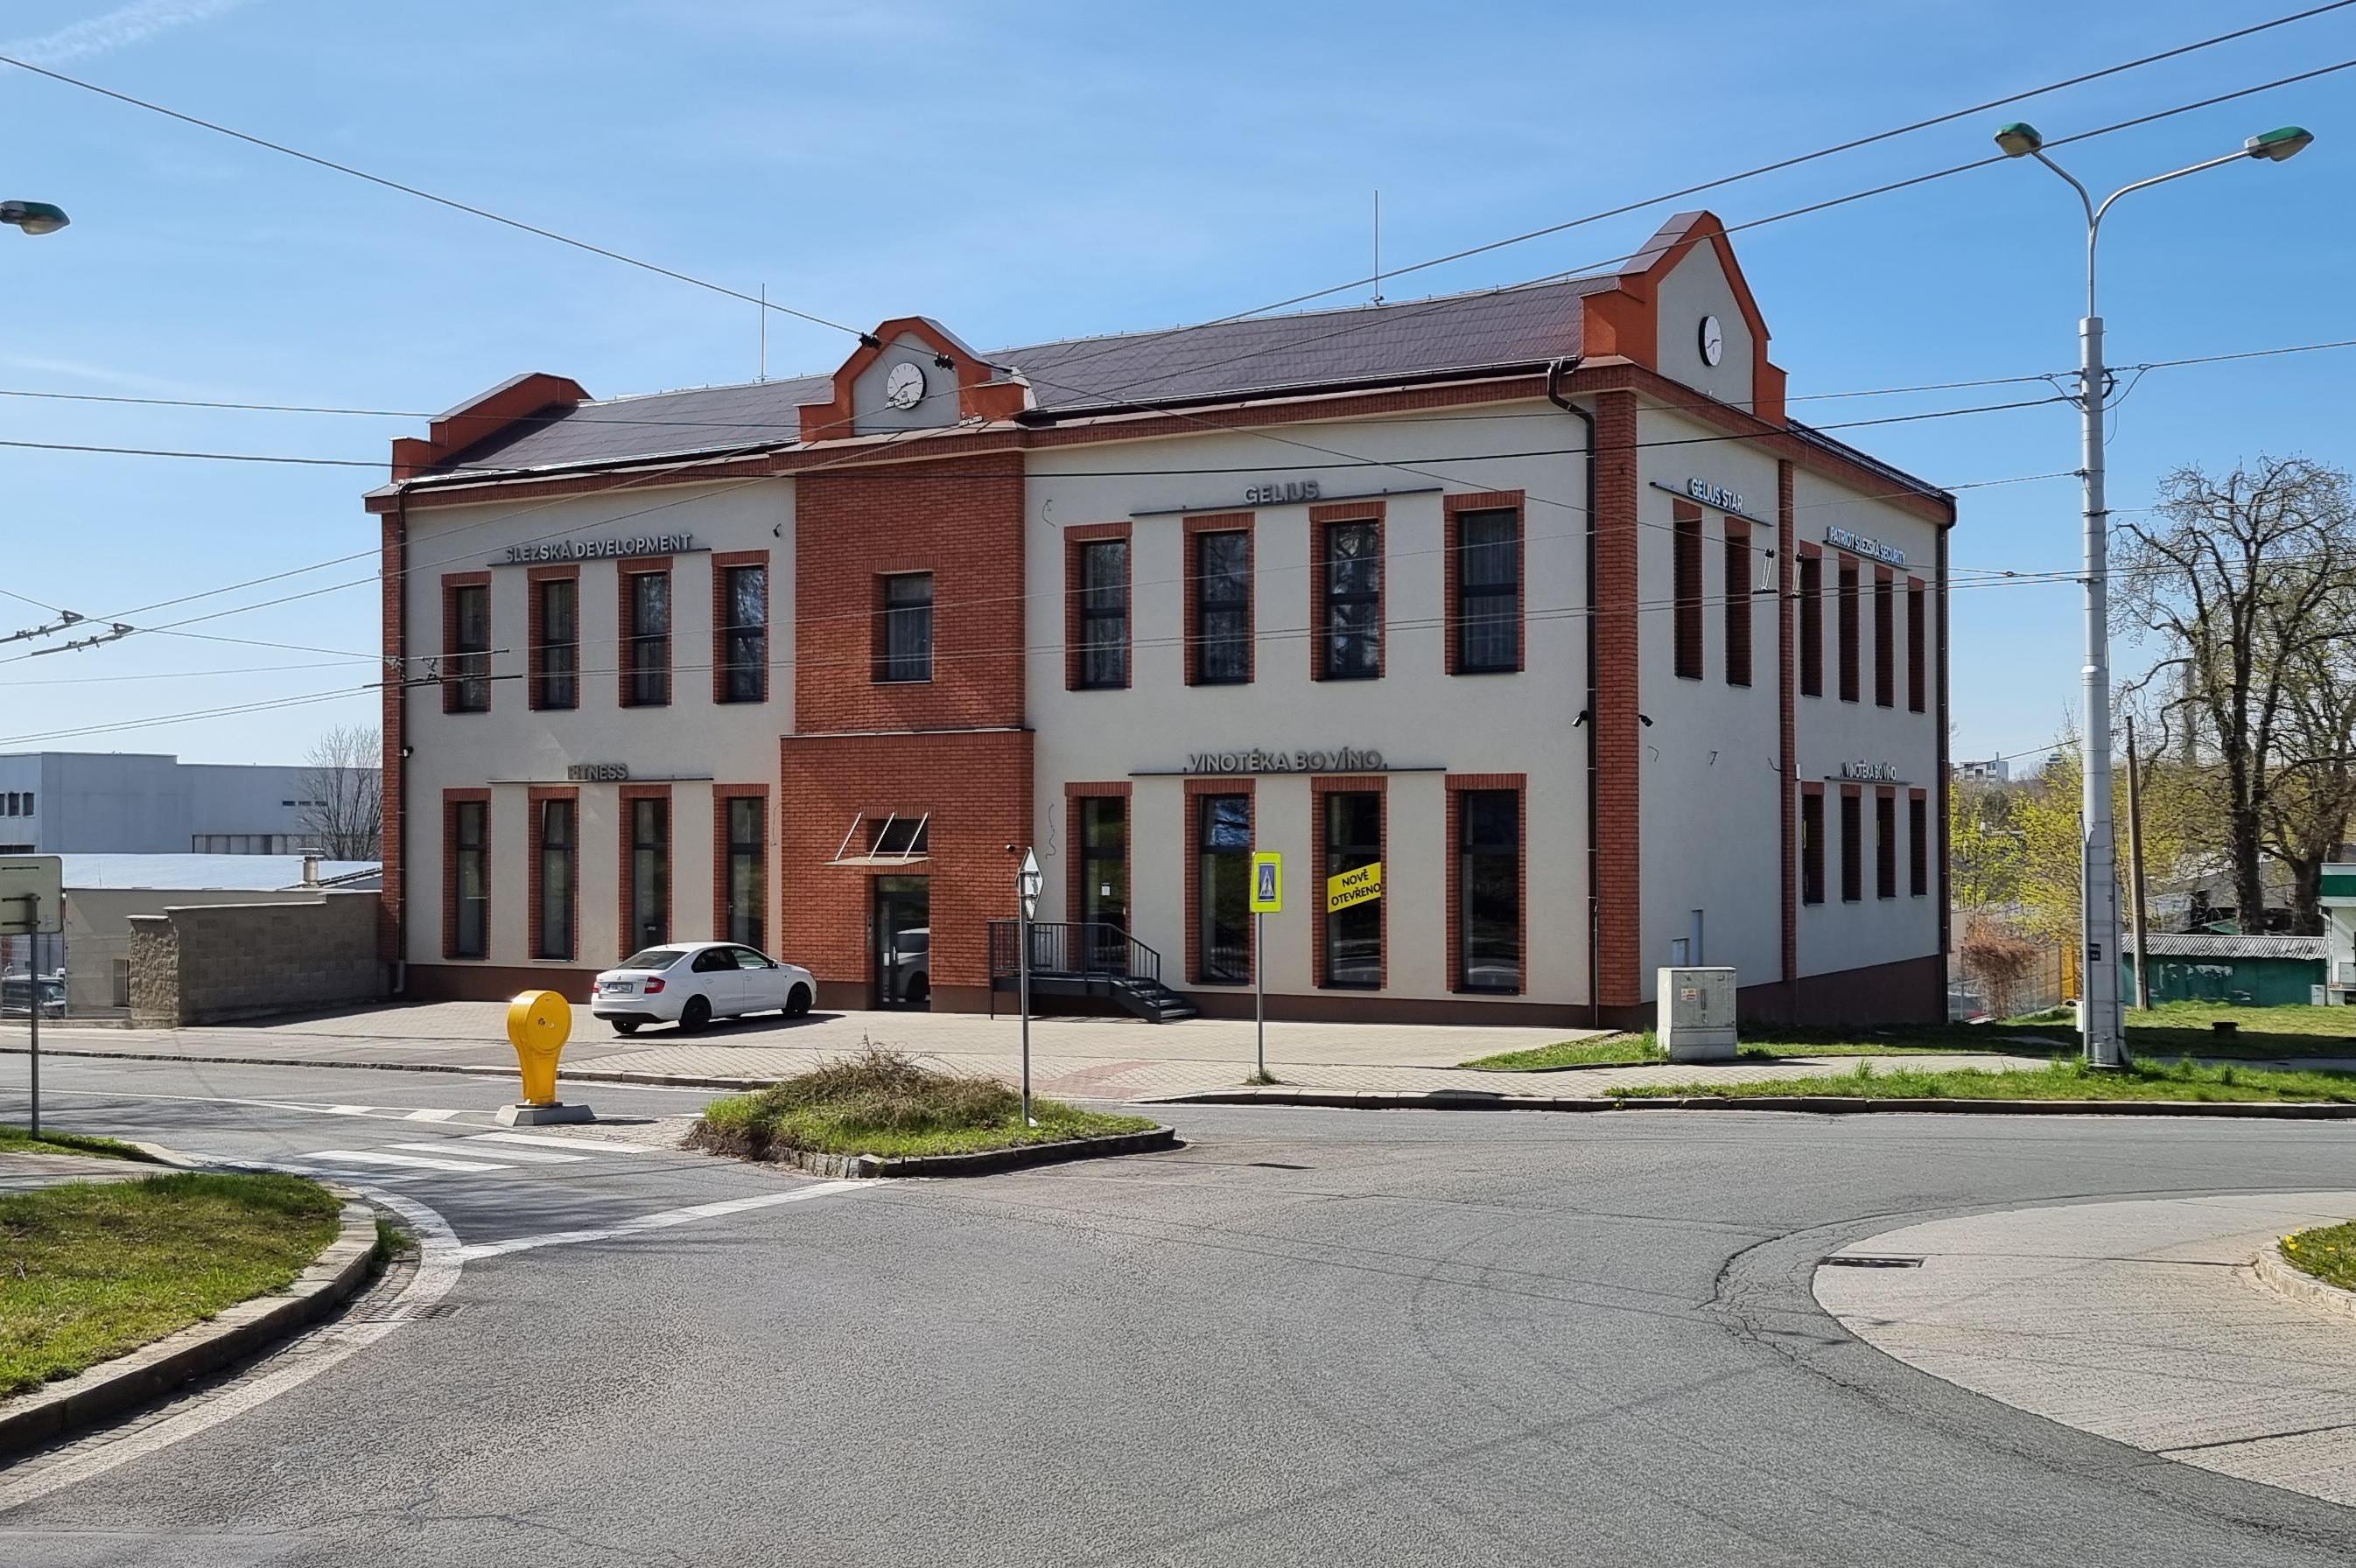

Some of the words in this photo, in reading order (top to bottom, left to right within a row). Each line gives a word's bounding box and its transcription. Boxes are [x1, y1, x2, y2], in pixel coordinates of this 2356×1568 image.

[1244, 480, 1319, 504] GELIUS
[1687, 477, 1721, 505] GELIUS
[1722, 489, 1743, 514] STAR
[505, 540, 572, 563] SLEZSKÁ
[575, 532, 692, 558] DEVELOPMENT
[1189, 748, 1291, 772] VINOTÉKA
[1342, 868, 1369, 888] NOVĚ
[1331, 883, 1381, 906] OTEVŘENO
